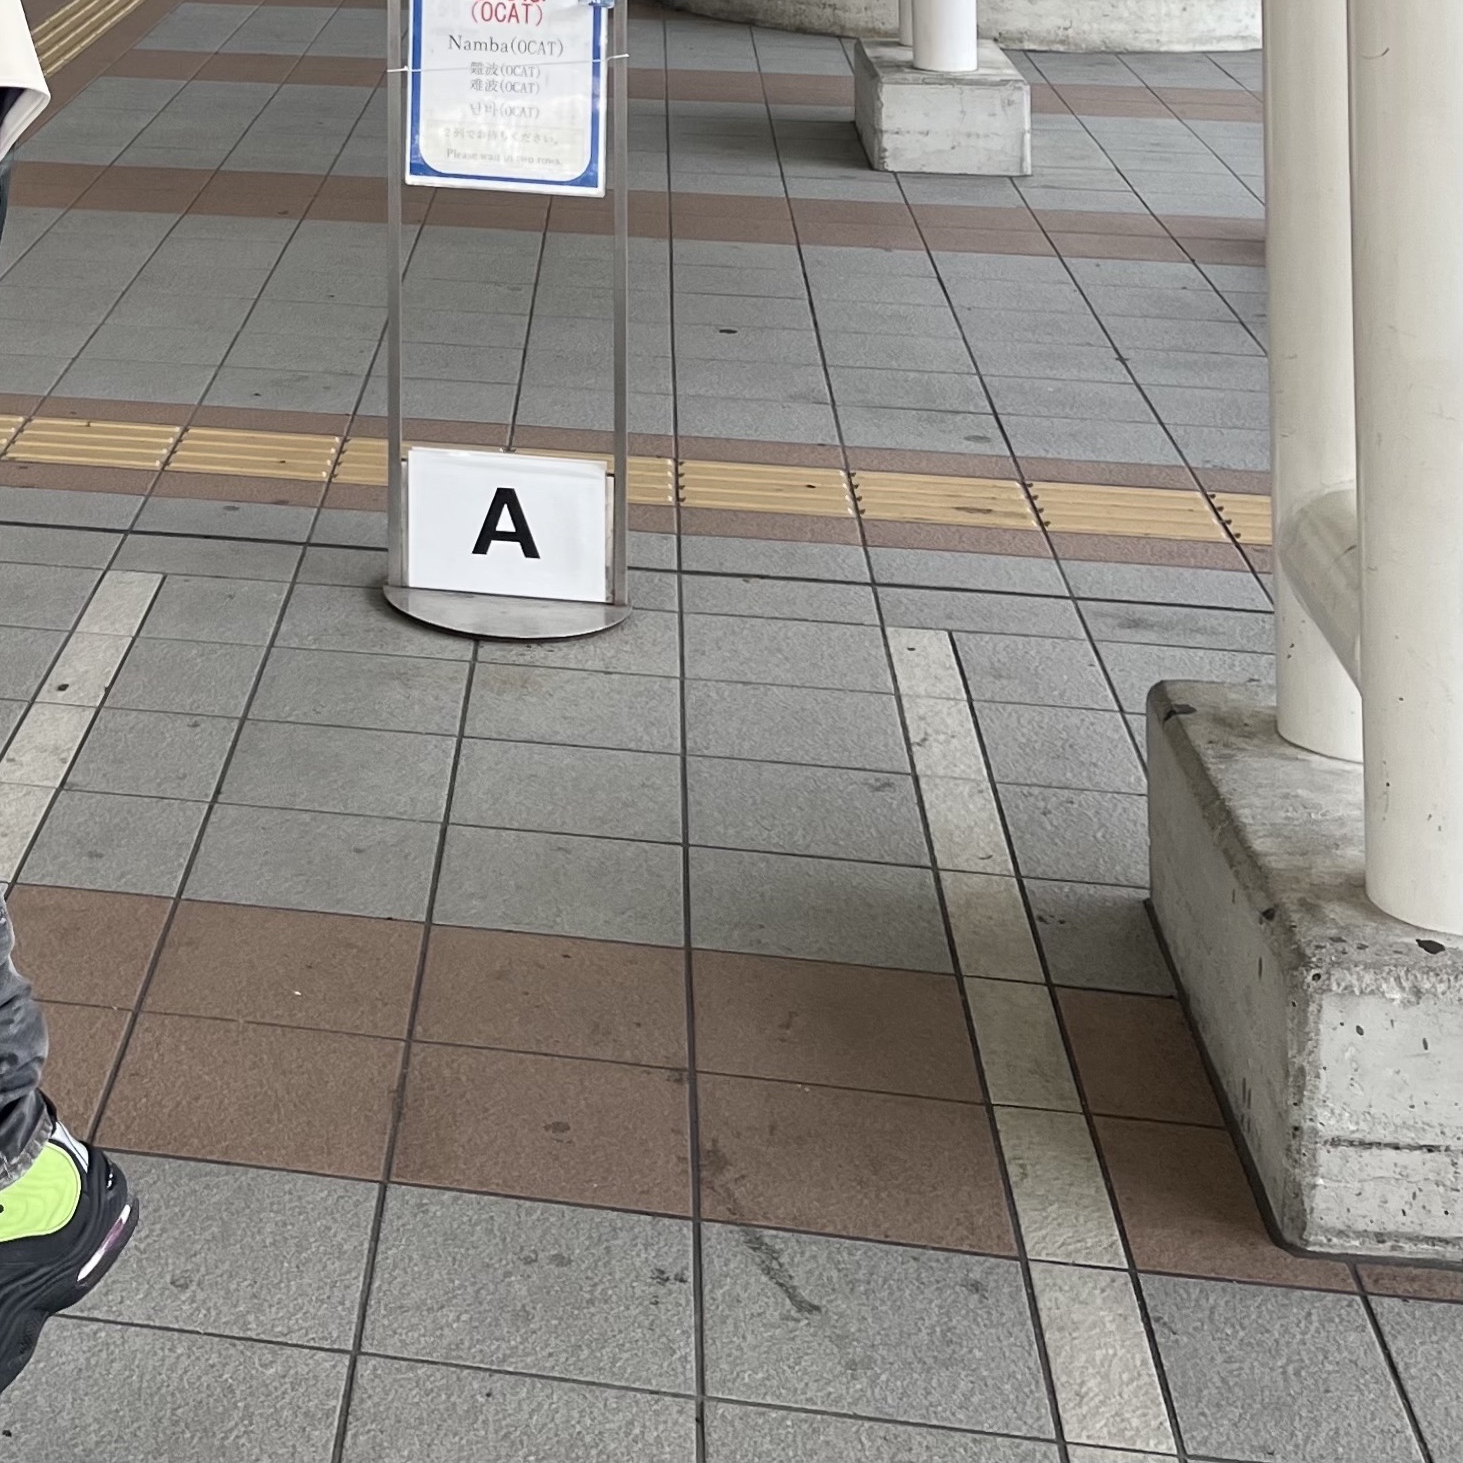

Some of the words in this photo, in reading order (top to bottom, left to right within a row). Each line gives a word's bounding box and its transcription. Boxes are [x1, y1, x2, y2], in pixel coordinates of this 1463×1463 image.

[471, 1, 543, 27] (OCAT)
[448, 34, 564, 58] Namba(OCAT)
[446, 148, 478, 160] Please
[472, 487, 541, 560] A
